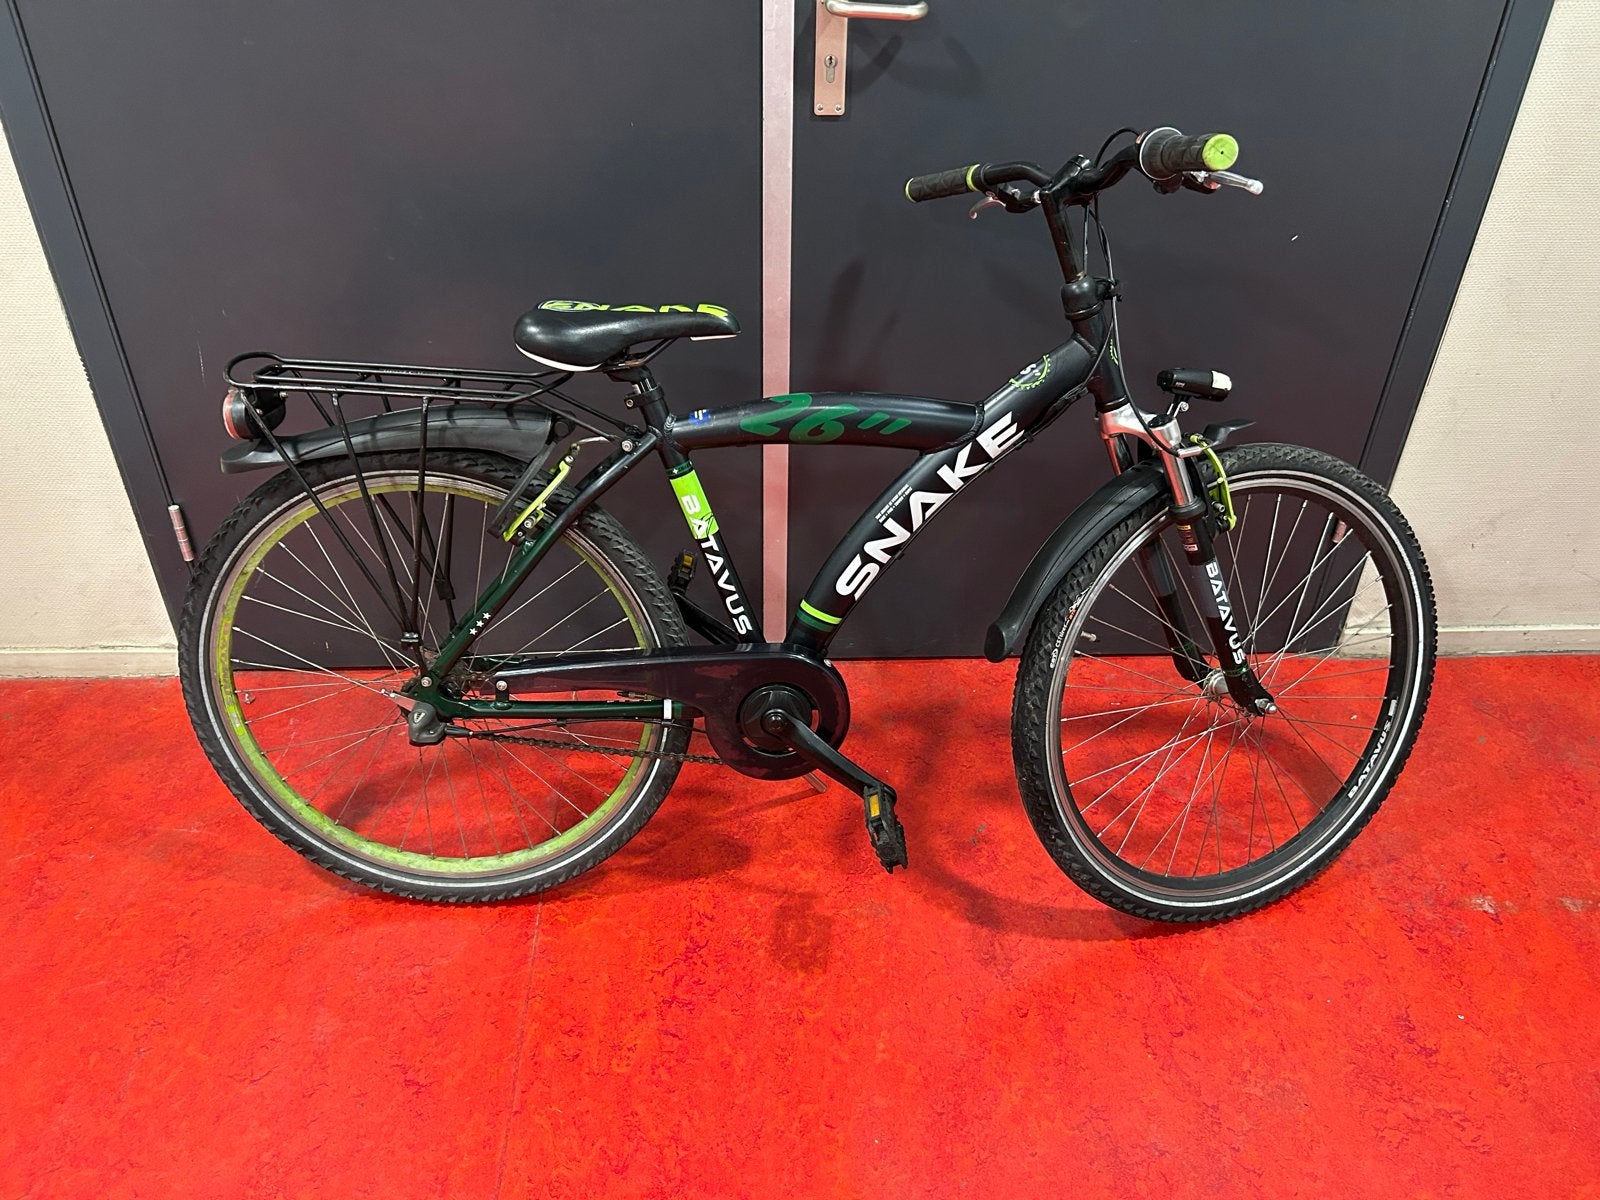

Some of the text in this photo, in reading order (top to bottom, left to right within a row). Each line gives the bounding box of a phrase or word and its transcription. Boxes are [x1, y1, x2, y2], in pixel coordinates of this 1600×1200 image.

[681, 494, 753, 636] BATAVUS
[836, 411, 1025, 601] SNAKE
[1204, 561, 1247, 665] BATAVUS
[1347, 720, 1392, 799] BATAVUS
